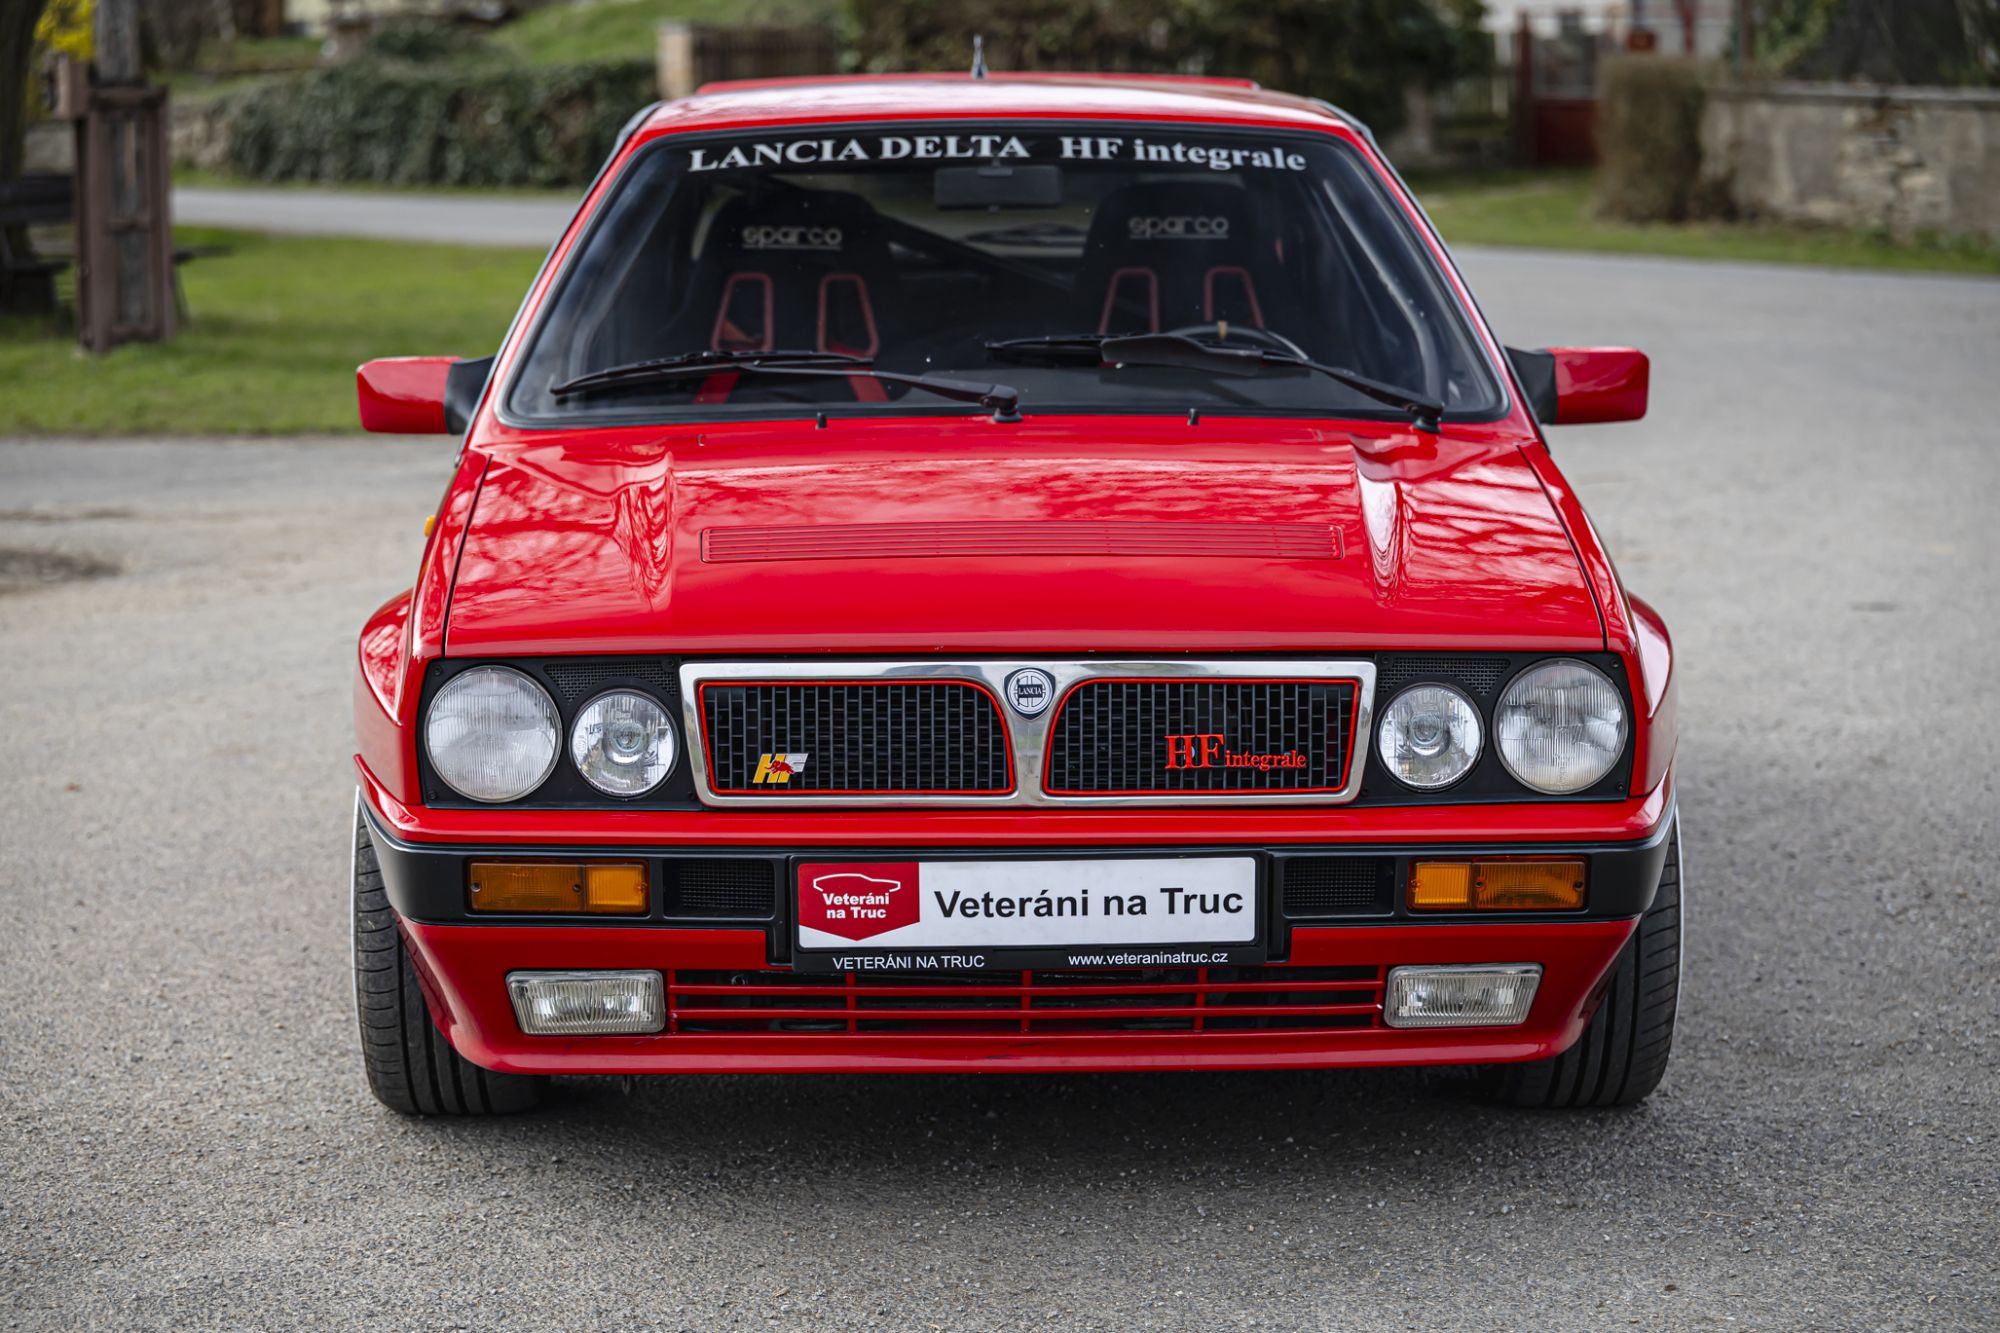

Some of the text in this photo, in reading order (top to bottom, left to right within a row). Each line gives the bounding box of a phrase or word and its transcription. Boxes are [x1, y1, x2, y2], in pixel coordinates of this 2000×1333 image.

[688, 136, 1306, 172] LANCIA DELTA HF integrale
[742, 227, 842, 249] sparco
[1128, 216, 1229, 238] sparco
[1165, 734, 1306, 772] HF integrale
[823, 892, 890, 906] Veteráni
[934, 887, 1244, 918] Veteráni na Truc
[826, 906, 887, 919] na Truc
[833, 954, 986, 969] VETERÁNI NA TRUC
[1068, 951, 1229, 966] www.veteraninatruc.cz
